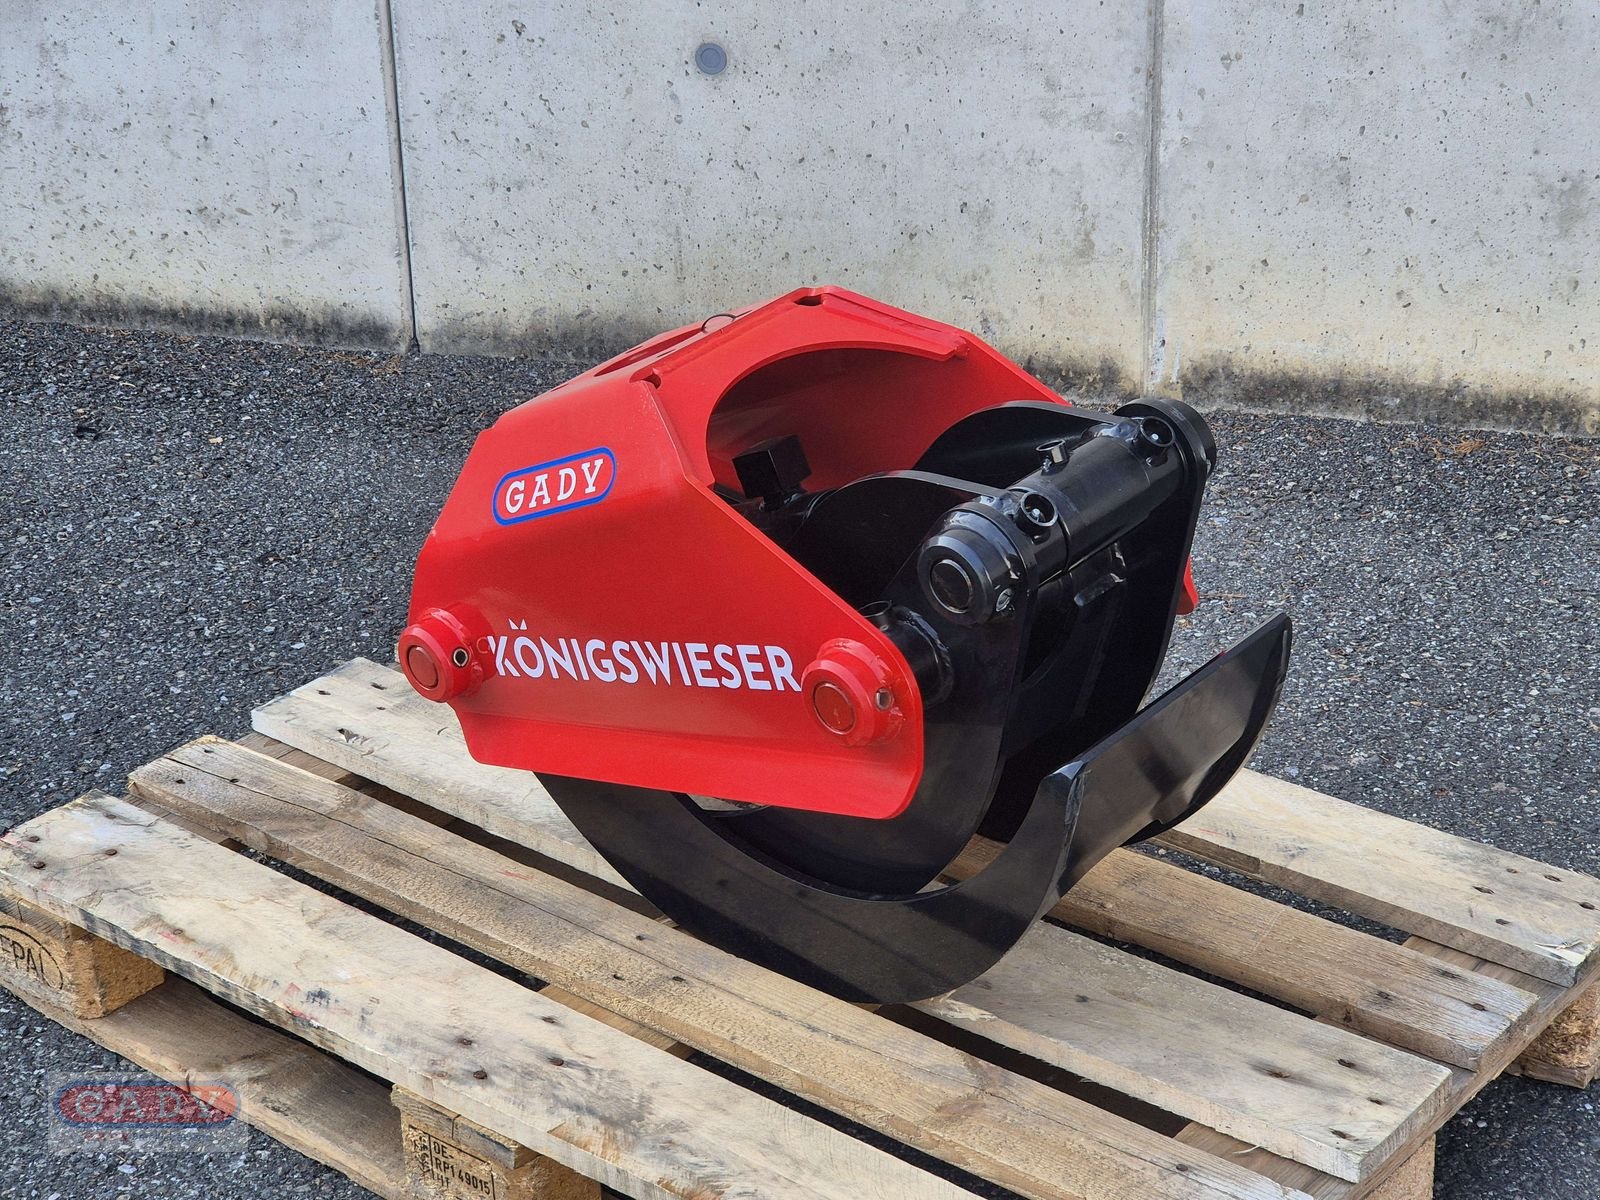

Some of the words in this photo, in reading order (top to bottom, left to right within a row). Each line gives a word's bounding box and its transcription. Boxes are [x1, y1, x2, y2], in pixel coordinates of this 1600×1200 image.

[505, 458, 604, 514] GADY
[487, 618, 802, 692] KÖNIGSWIESER
[458, 1169, 490, 1195] 49015
